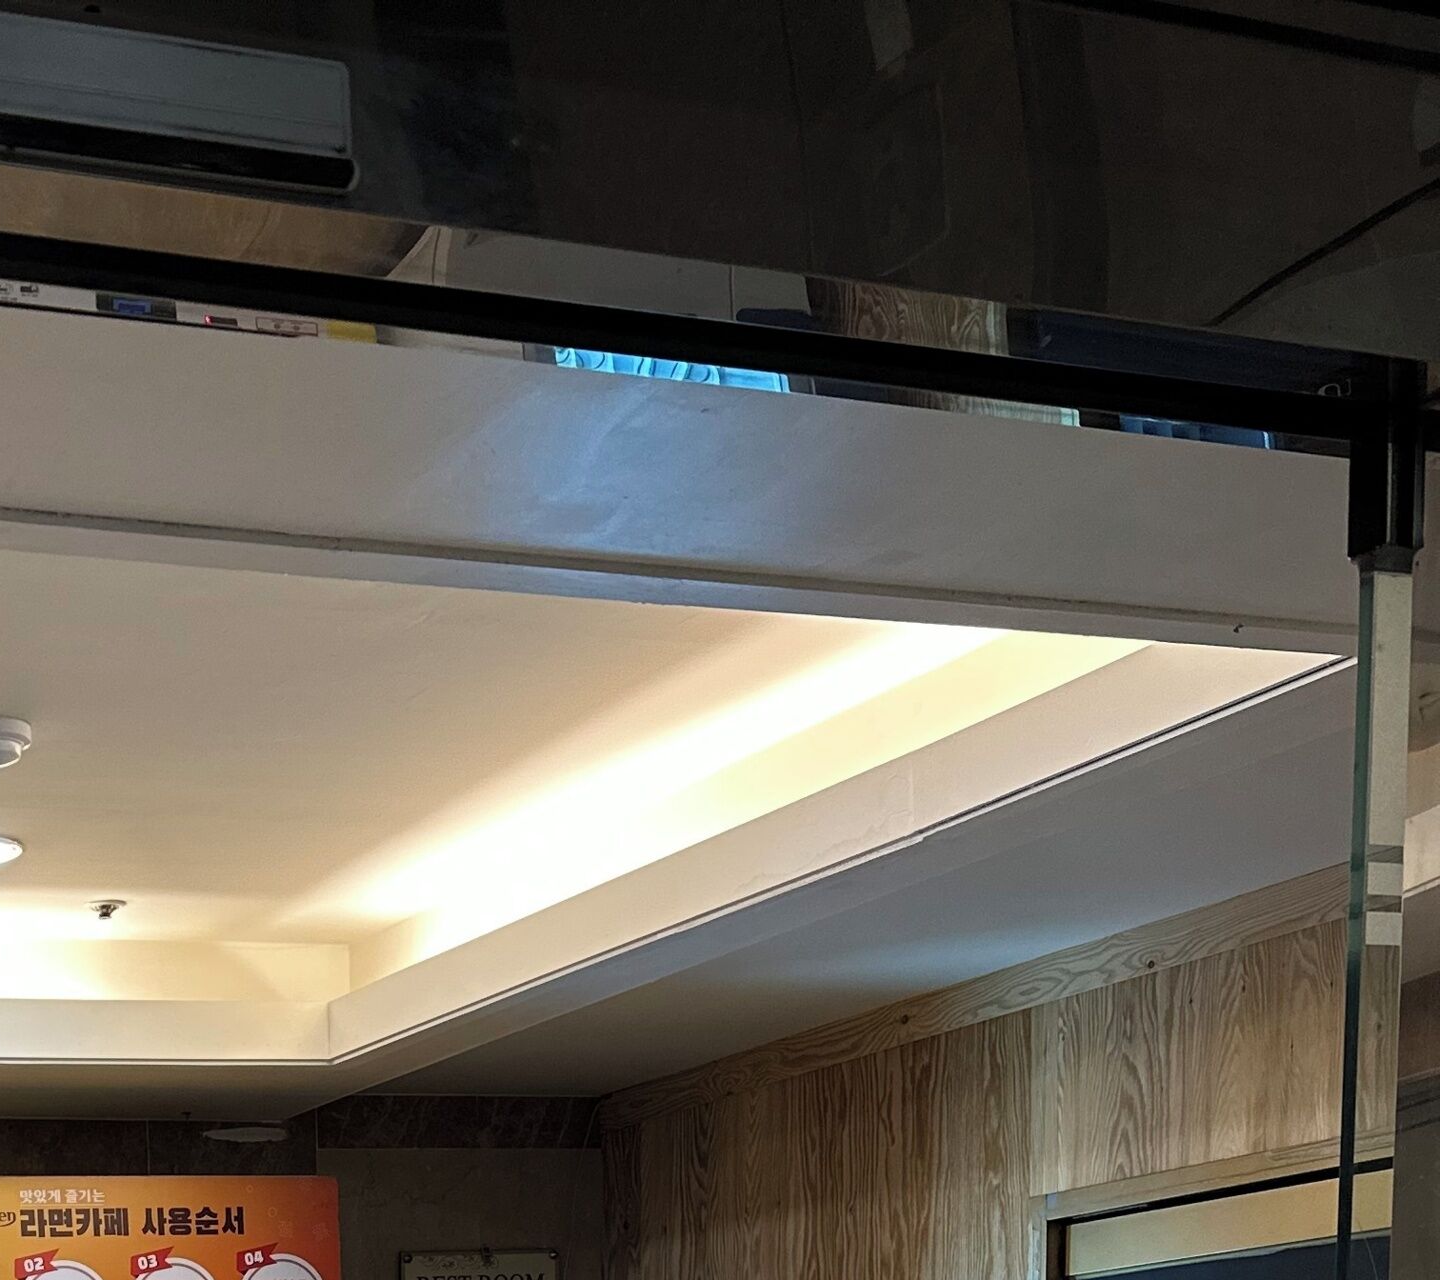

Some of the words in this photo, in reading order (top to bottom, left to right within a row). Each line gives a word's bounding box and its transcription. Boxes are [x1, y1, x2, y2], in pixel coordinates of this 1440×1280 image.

[20, 1189, 61, 1203] 맛있게
[65, 1189, 105, 1203] 즐기는
[20, 1208, 129, 1237] 라면카페
[142, 1206, 245, 1236] 사용순서
[24, 1257, 45, 1272] 02
[137, 1254, 158, 1269] 03
[244, 1250, 264, 1266] 04
